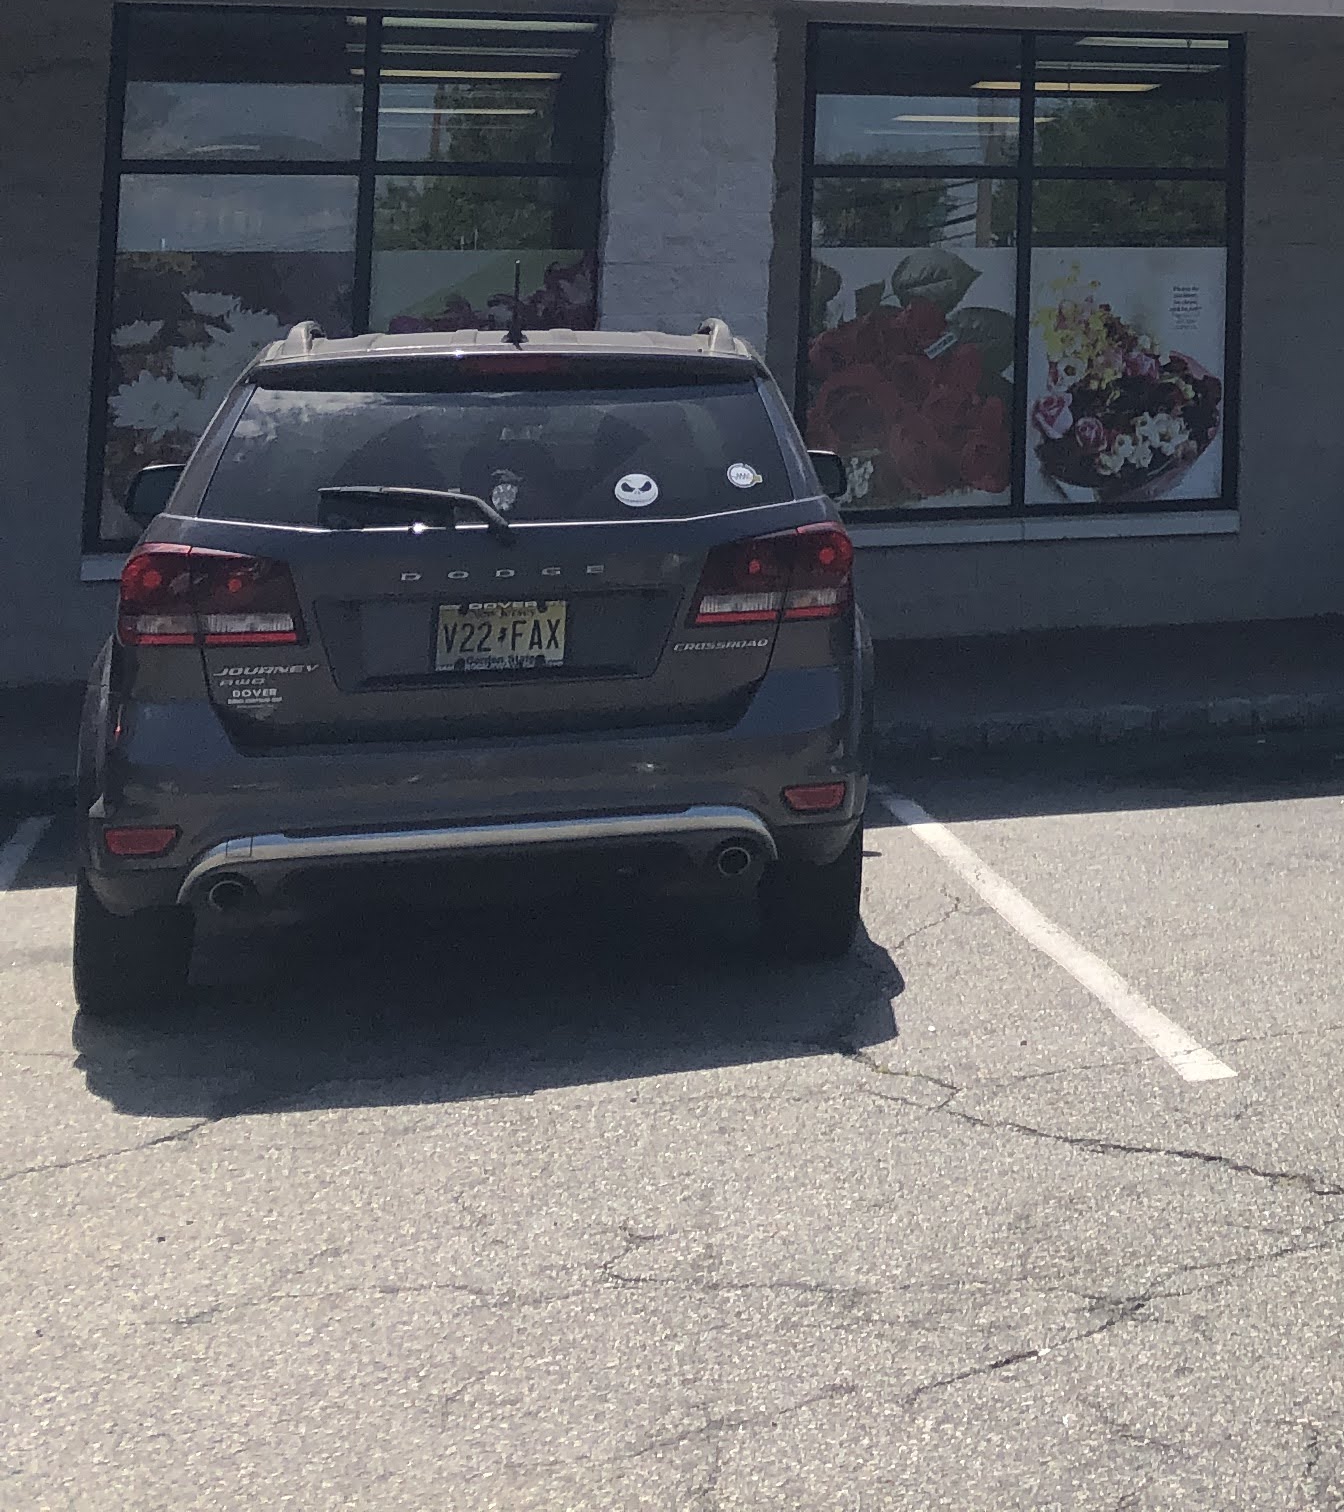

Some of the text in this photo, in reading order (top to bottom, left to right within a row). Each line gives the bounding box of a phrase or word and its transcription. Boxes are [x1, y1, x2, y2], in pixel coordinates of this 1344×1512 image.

[401, 564, 604, 581] DODGE
[468, 600, 537, 610] DOVER
[673, 639, 769, 651] CROSSROAD
[213, 664, 319, 676] JOURNEY
[232, 688, 278, 697] DOVER
